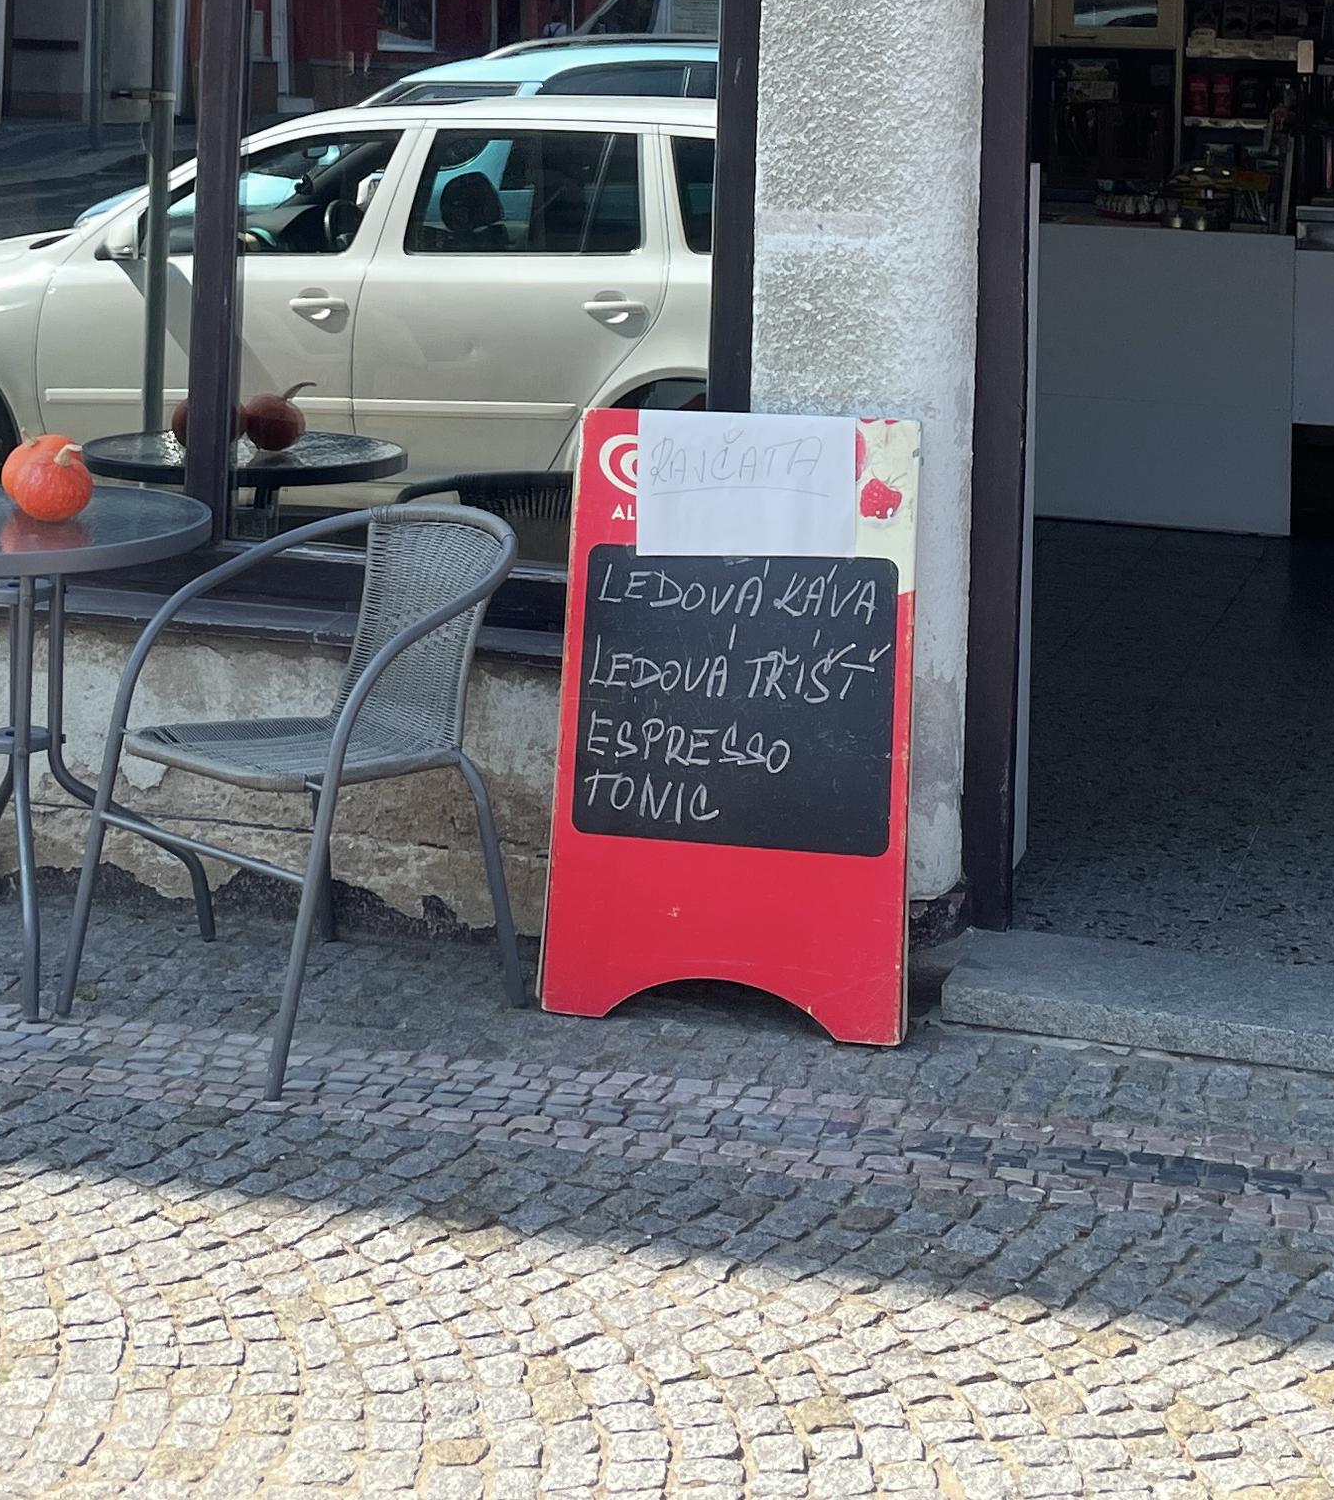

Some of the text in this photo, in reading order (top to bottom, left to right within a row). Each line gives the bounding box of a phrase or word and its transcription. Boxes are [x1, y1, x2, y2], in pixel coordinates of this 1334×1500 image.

[650, 430, 823, 485] RAJČATA
[598, 559, 878, 624] LEDOVÁ KÁVA
[588, 624, 737, 698] LEDOVÁ
[586, 710, 792, 774] ESPRESSO
[584, 771, 720, 825] TONIC
